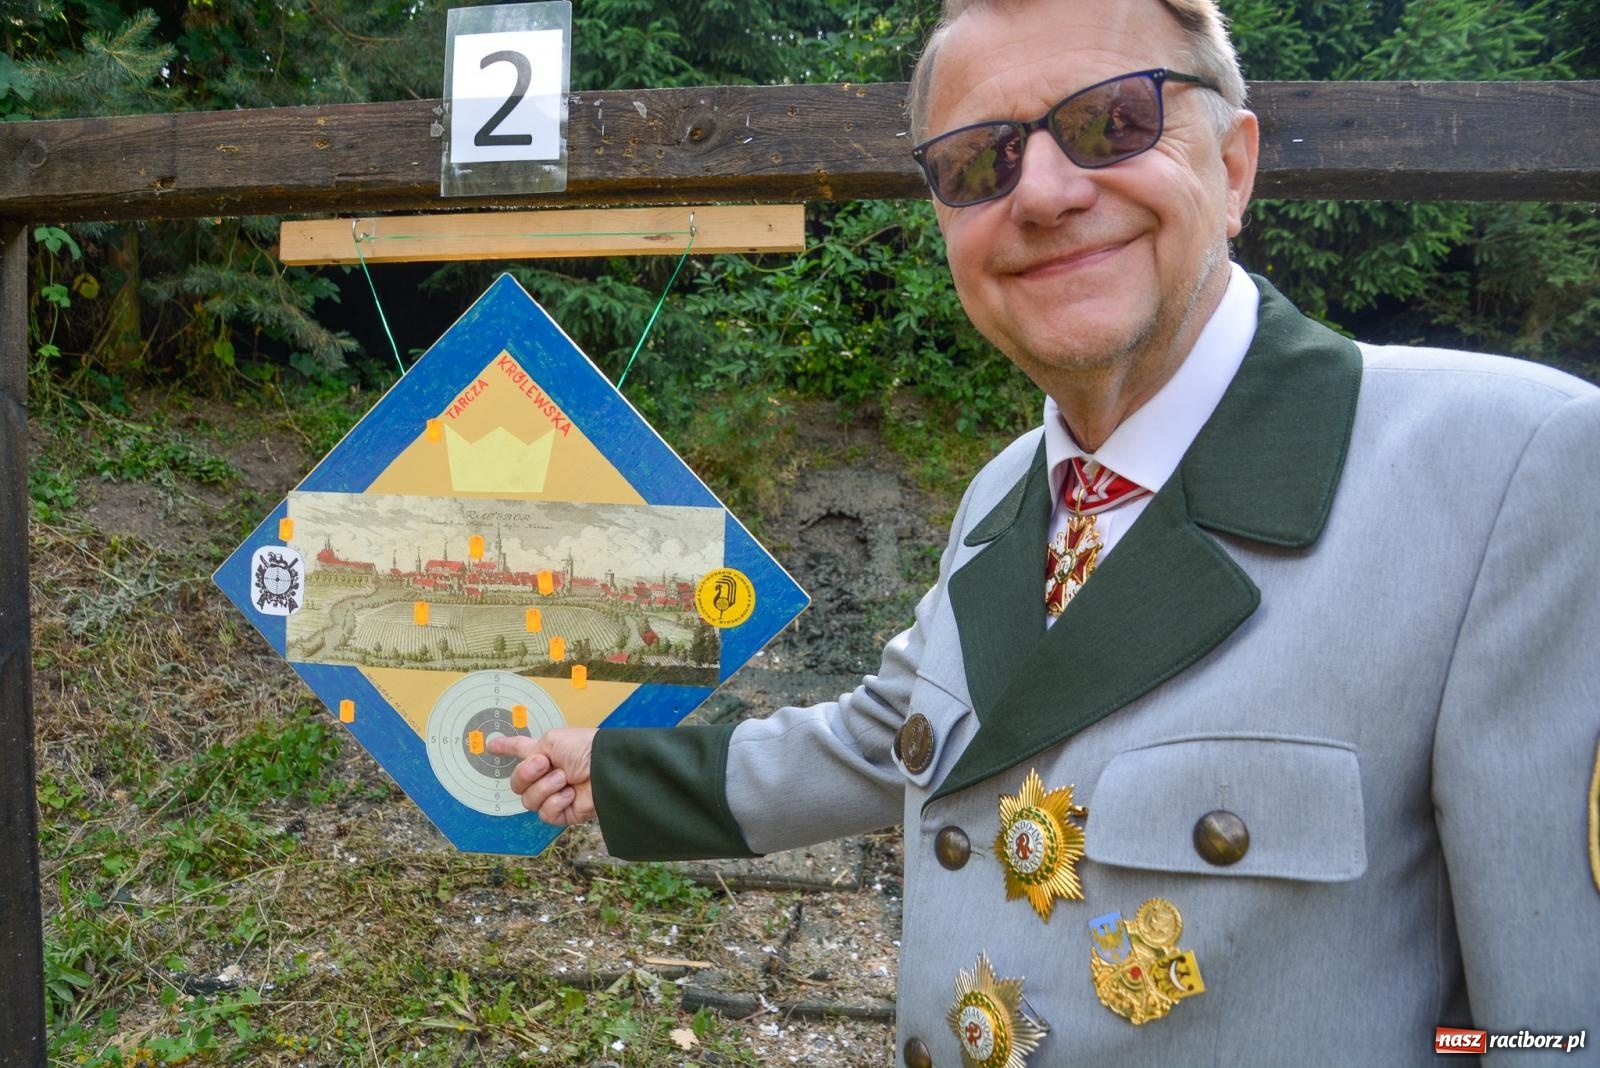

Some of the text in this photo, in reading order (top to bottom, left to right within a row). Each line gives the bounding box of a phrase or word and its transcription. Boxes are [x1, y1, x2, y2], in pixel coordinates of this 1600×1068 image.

[474, 50, 532, 147] 2
[445, 379, 489, 420] TARCZA
[494, 686, 500, 694] 6
[494, 698, 500, 706] 7
[494, 710, 500, 718] 8
[494, 722, 500, 730] 9
[431, 736, 437, 744] 5
[442, 736, 448, 744] 6
[494, 769, 500, 777] 8
[494, 780, 500, 788] 7
[494, 792, 501, 800] 6
[494, 804, 501, 812] 5
